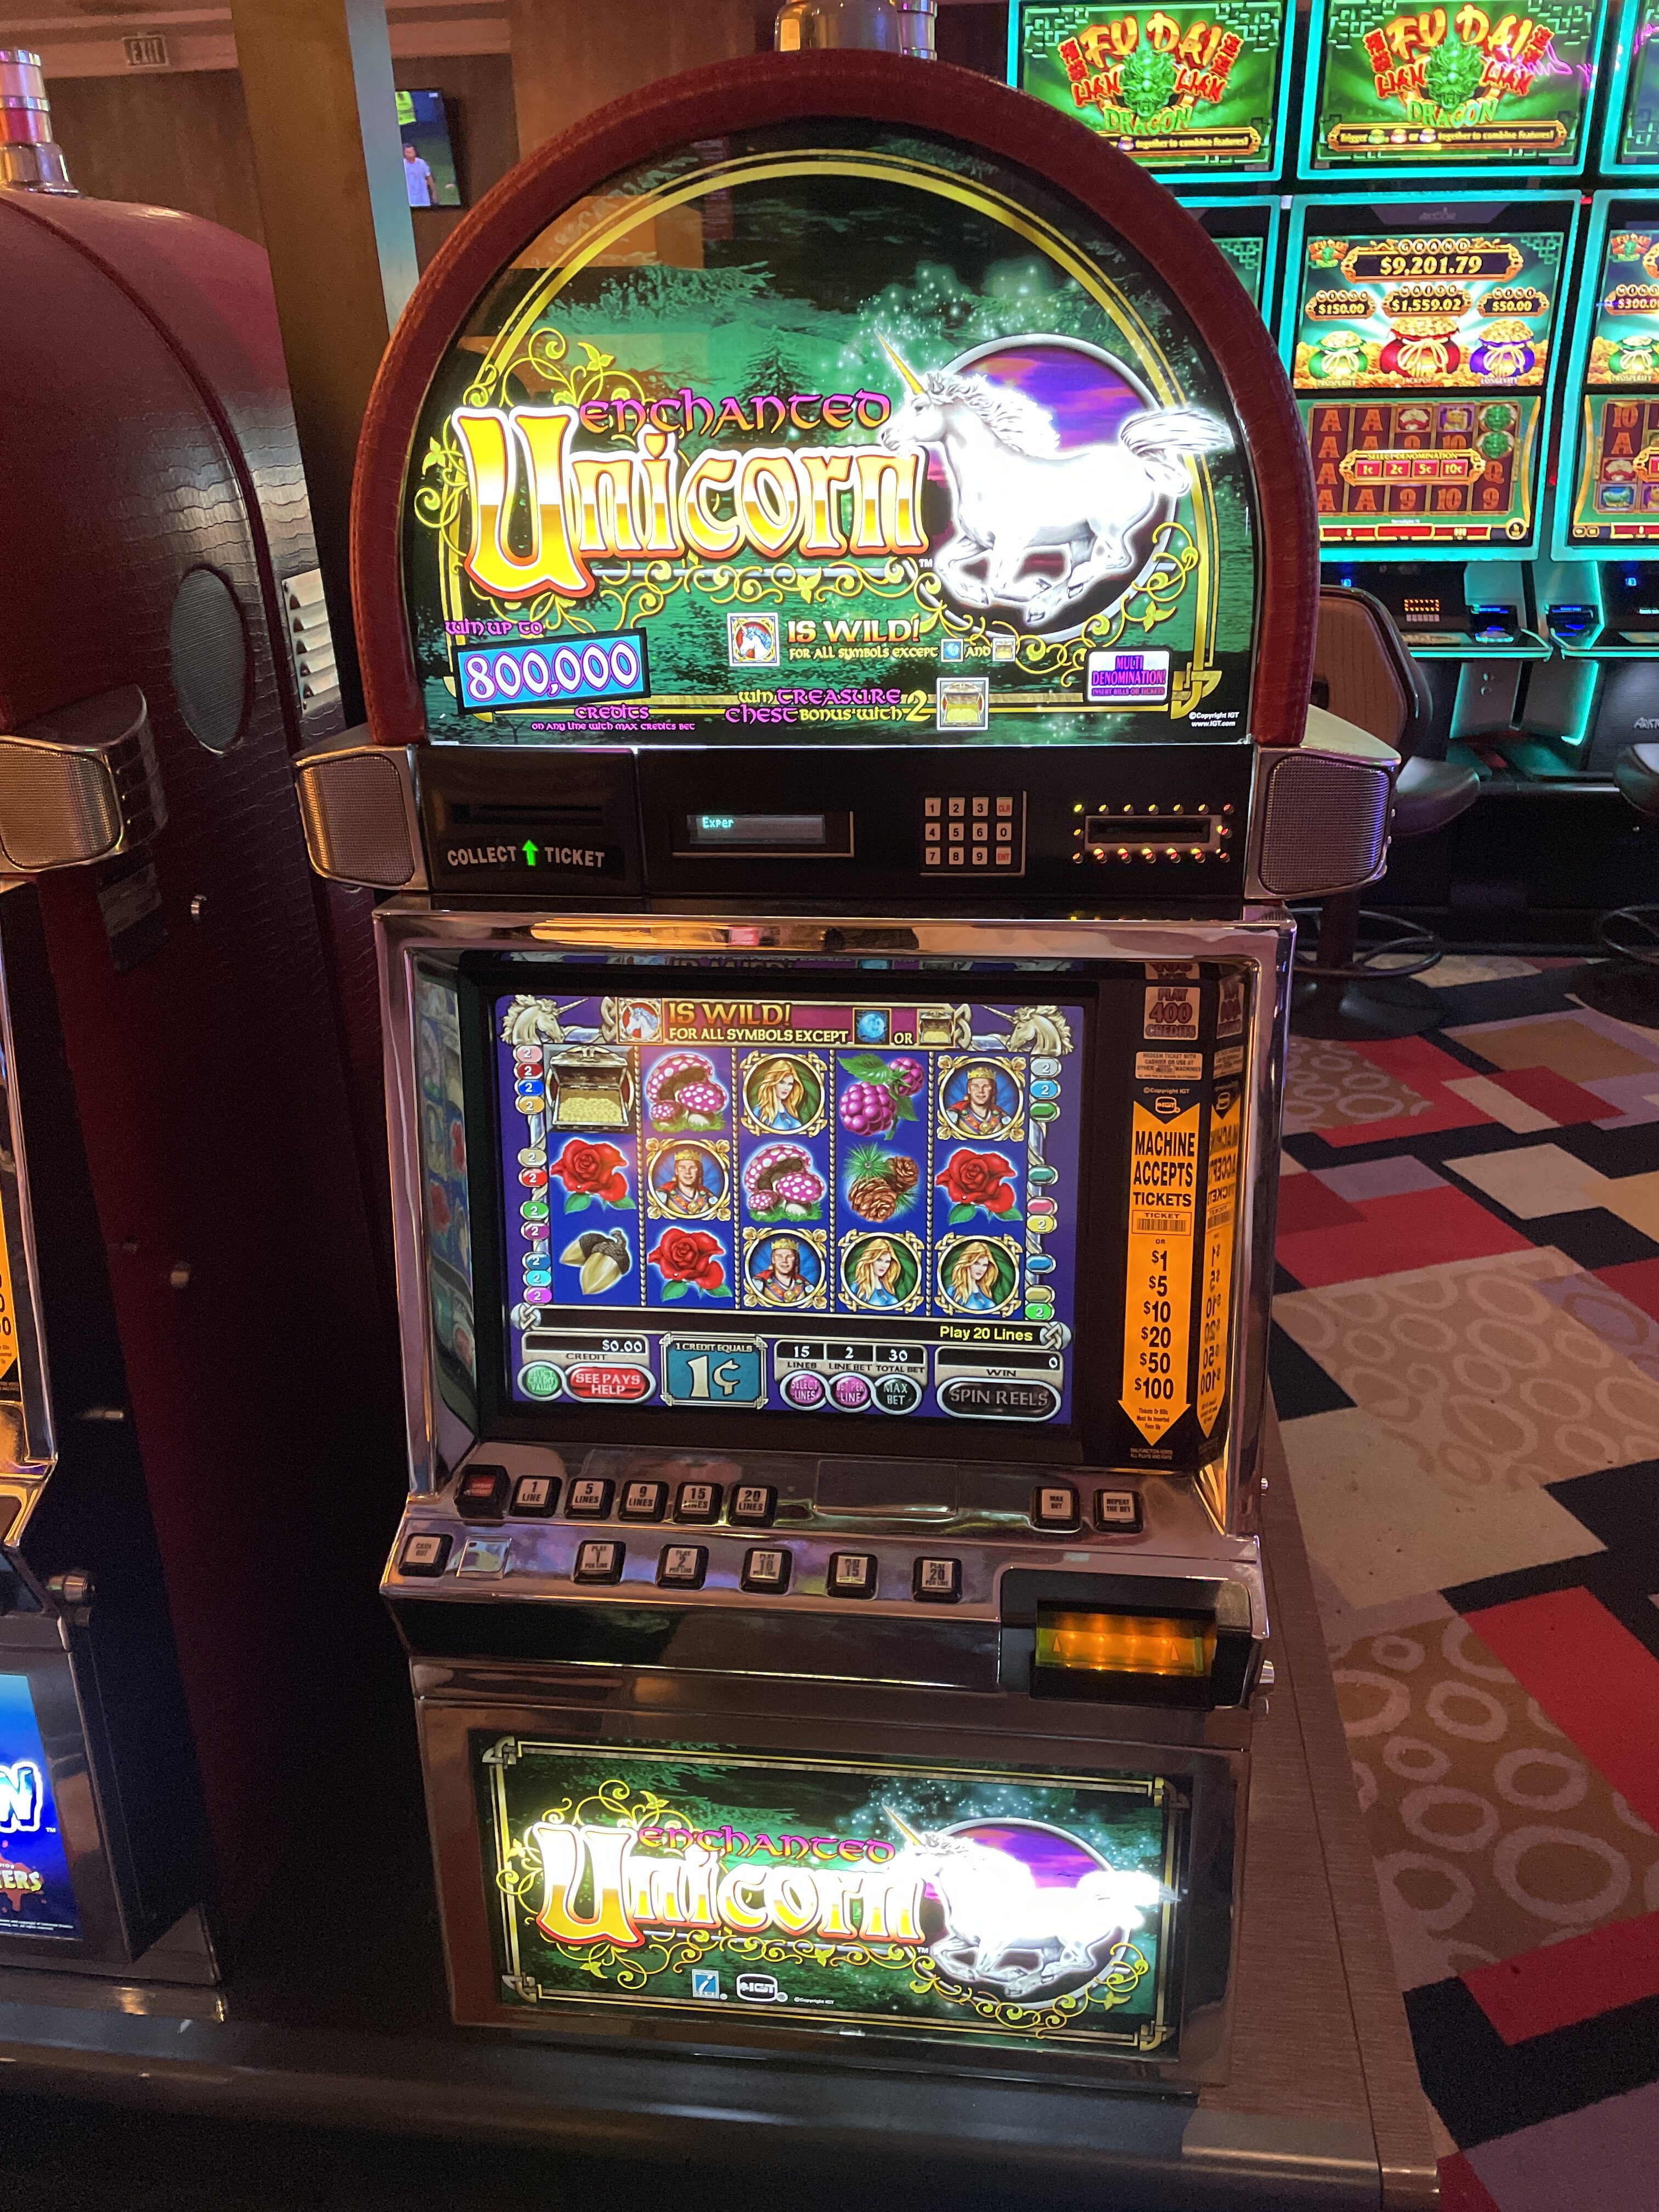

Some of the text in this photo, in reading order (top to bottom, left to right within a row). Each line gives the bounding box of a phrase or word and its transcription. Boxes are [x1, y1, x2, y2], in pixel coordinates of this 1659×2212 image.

[1386, 8, 1448, 64] FU
[1456, 3, 1533, 62] DAI
[1077, 15, 1138, 71] FU
[1147, 11, 1223, 73] DAI
[131, 40, 160, 64] EXIT
[1175, 69, 1228, 103] LIAN
[1374, 61, 1426, 99] LIAN
[1072, 70, 1123, 107] LIAN
[1407, 98, 1498, 128] DRAGON
[1104, 106, 1193, 135] DRAGON
[1380, 256, 1482, 276] $9,201.79
[1318, 303, 1364, 314] $150.00
[1391, 298, 1461, 312] $1,559.02
[1492, 300, 1532, 311] $50.00
[488, 622, 512, 635] UP
[787, 616, 920, 643] IS WILD!
[789, 648, 811, 660] FOR
[814, 646, 835, 659] ALL
[1115, 655, 1144, 670] MULTI
[465, 641, 640, 702] 800,000
[1092, 669, 1166, 686] DENOMINATION!
[1092, 688, 1113, 696] INSERT
[1130, 687, 1139, 695] OR
[1141, 686, 1165, 695] TICKETS
[776, 689, 901, 706] TREASURE
[905, 690, 930, 723] 2
[930, 804, 935, 812] 1
[953, 804, 959, 812] 2
[978, 804, 983, 812] 3
[998, 804, 1010, 812] CLR
[929, 828, 935, 837] 4
[953, 828, 958, 837] 5
[977, 828, 983, 837] 6
[1001, 828, 1006, 837] 0
[447, 845, 605, 868] COLLECT TICKET
[930, 853, 935, 861] 7
[953, 853, 958, 861] 8
[977, 853, 982, 861] 9
[1158, 988, 1188, 1001] PLAY
[669, 1003, 791, 1025] IS WILD!
[1149, 1002, 1193, 1024] 400
[669, 1028, 913, 1045] FOR ALL SYMBOLS EXCEPT OR
[1146, 1024, 1196, 1037] CREDITS
[524, 1049, 531, 1058] 2
[1041, 1085, 1049, 1095] 2
[1135, 1131, 1195, 1157] MACHINE
[528, 1153, 536, 1163] 2
[1133, 1161, 1193, 1187] ACCEPTS
[1133, 1192, 1192, 1207] TICKETS
[531, 1206, 538, 1215] 2
[1152, 1250, 1168, 1271] $1
[1148, 1276, 1168, 1297] $5
[534, 1291, 541, 1301] 2
[1036, 1308, 1043, 1317] 2
[1143, 1301, 1171, 1323] $10
[940, 1327, 1032, 1341] Play 20 Lines
[1141, 1326, 1171, 1349] $20
[682, 1343, 715, 1351] CREDIT
[717, 1344, 753, 1353] EQUALS
[794, 1345, 810, 1358] 15
[845, 1346, 854, 1359] 2
[889, 1349, 908, 1362] 30
[1048, 1357, 1057, 1369] 0
[1139, 1352, 1170, 1374] $50
[687, 1355, 740, 1398] 1¢
[986, 1369, 1017, 1377] WIN
[576, 1374, 640, 1385] SEE PAYS
[791, 1379, 818, 1390] SELECT
[591, 1385, 625, 1395] HELP
[837, 1381, 864, 1392] BET PER
[884, 1383, 907, 1393] MAX
[1135, 1377, 1173, 1401] $100
[794, 1390, 815, 1400] LINES
[840, 1392, 861, 1402] LINE
[887, 1395, 905, 1405] BET
[950, 1389, 1048, 1407] SPIN REELS
[532, 1482, 538, 1492] 1
[585, 1483, 594, 1494] 5
[640, 1486, 647, 1497] 9
[691, 1488, 706, 1499] 15
[744, 1490, 761, 1502] 20
[684, 1500, 708, 1509] LINES
[739, 1503, 763, 1511] LINES
[595, 1553, 601, 1562] 1
[678, 1556, 686, 1567] 2
[760, 1560, 772, 1571] 10
[845, 1565, 859, 1577] 15
[930, 1568, 945, 1581] 20
[749, 1983, 775, 1993] IGT
